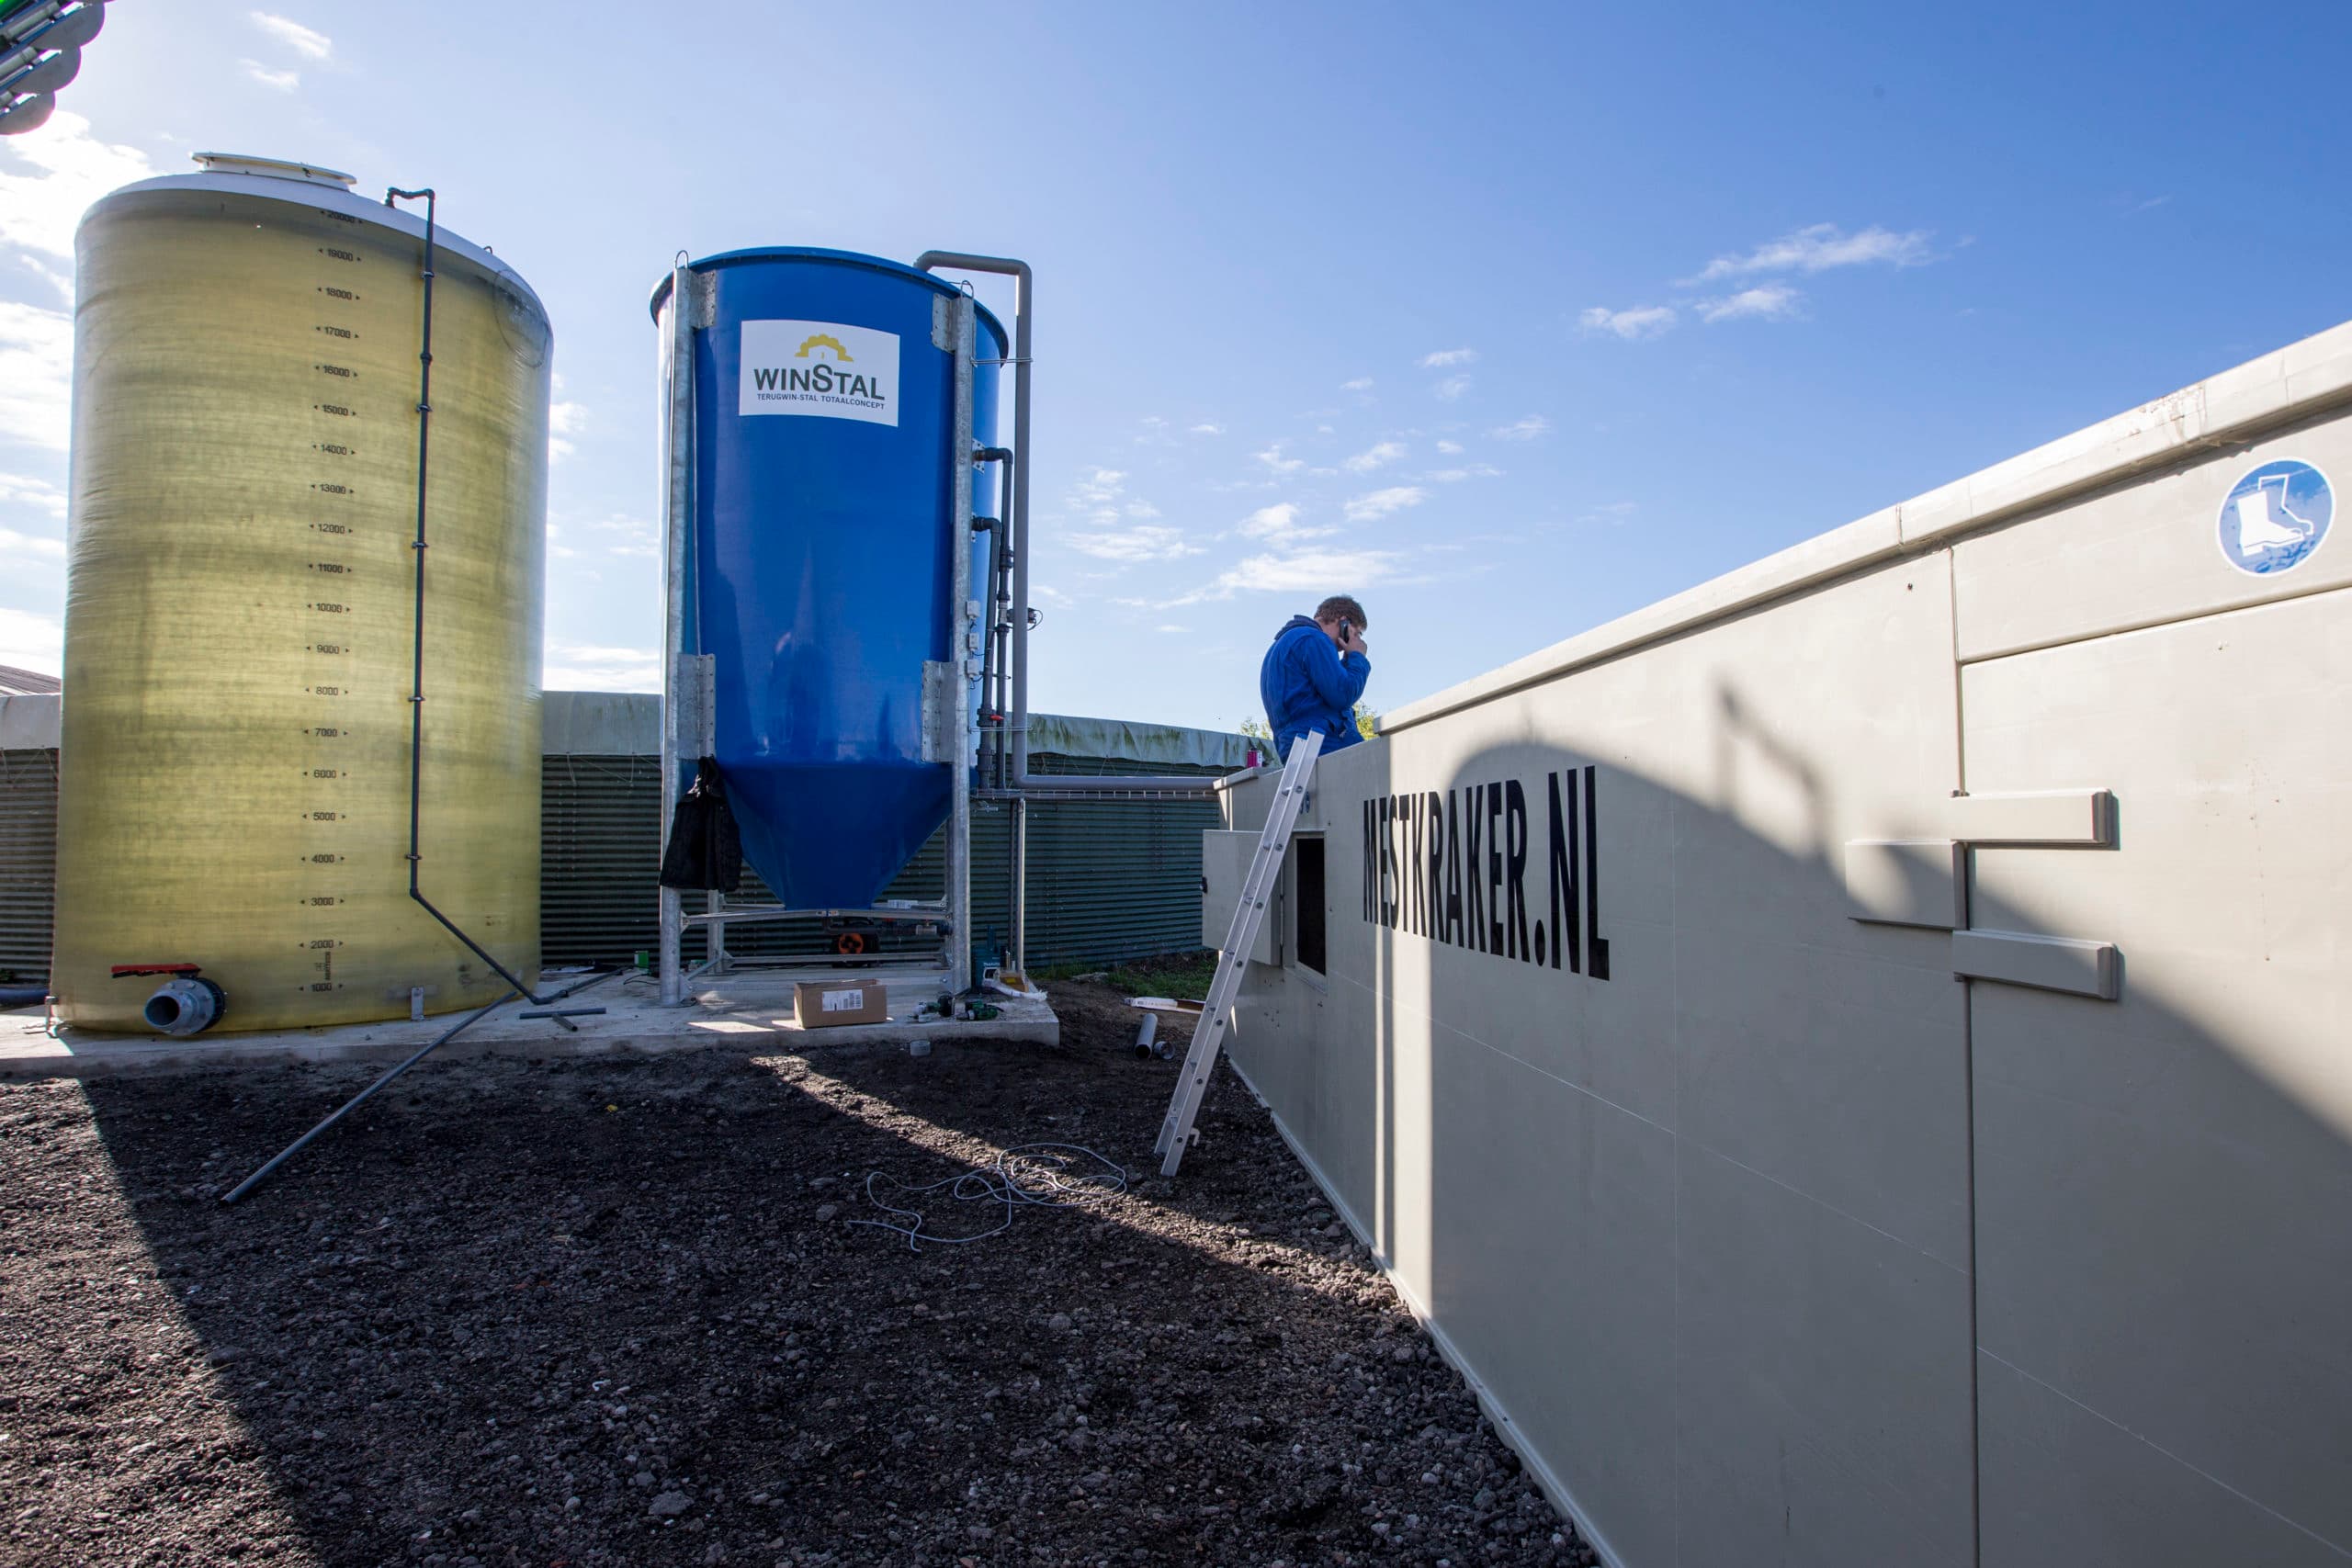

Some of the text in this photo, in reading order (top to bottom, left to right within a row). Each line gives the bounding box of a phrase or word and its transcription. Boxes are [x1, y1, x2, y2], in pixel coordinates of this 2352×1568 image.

[327, 248, 354, 262] 19000
[324, 326, 351, 339] 17000
[323, 366, 350, 378] 16000
[753, 364, 885, 400] WINSTAL
[757, 393, 885, 410] TERUGWIN-STAL TOTAALCONCEPT
[322, 404, 349, 416] 15000
[322, 444, 347, 456] 14000
[321, 483, 346, 495] 13000
[318, 524, 345, 535] 12000
[318, 563, 344, 574] 11000
[316, 603, 343, 614] 10000
[316, 644, 340, 655] 9000
[315, 686, 339, 696] 8000
[315, 728, 338, 738] 7000
[313, 769, 337, 779] 6000
[313, 812, 336, 821] 5000
[311, 854, 335, 863] 4000
[1363, 765, 1610, 981] MESTKRAKER.NL
[311, 897, 334, 907] 3000
[311, 940, 334, 949] 2000
[311, 982, 333, 992] 1000
